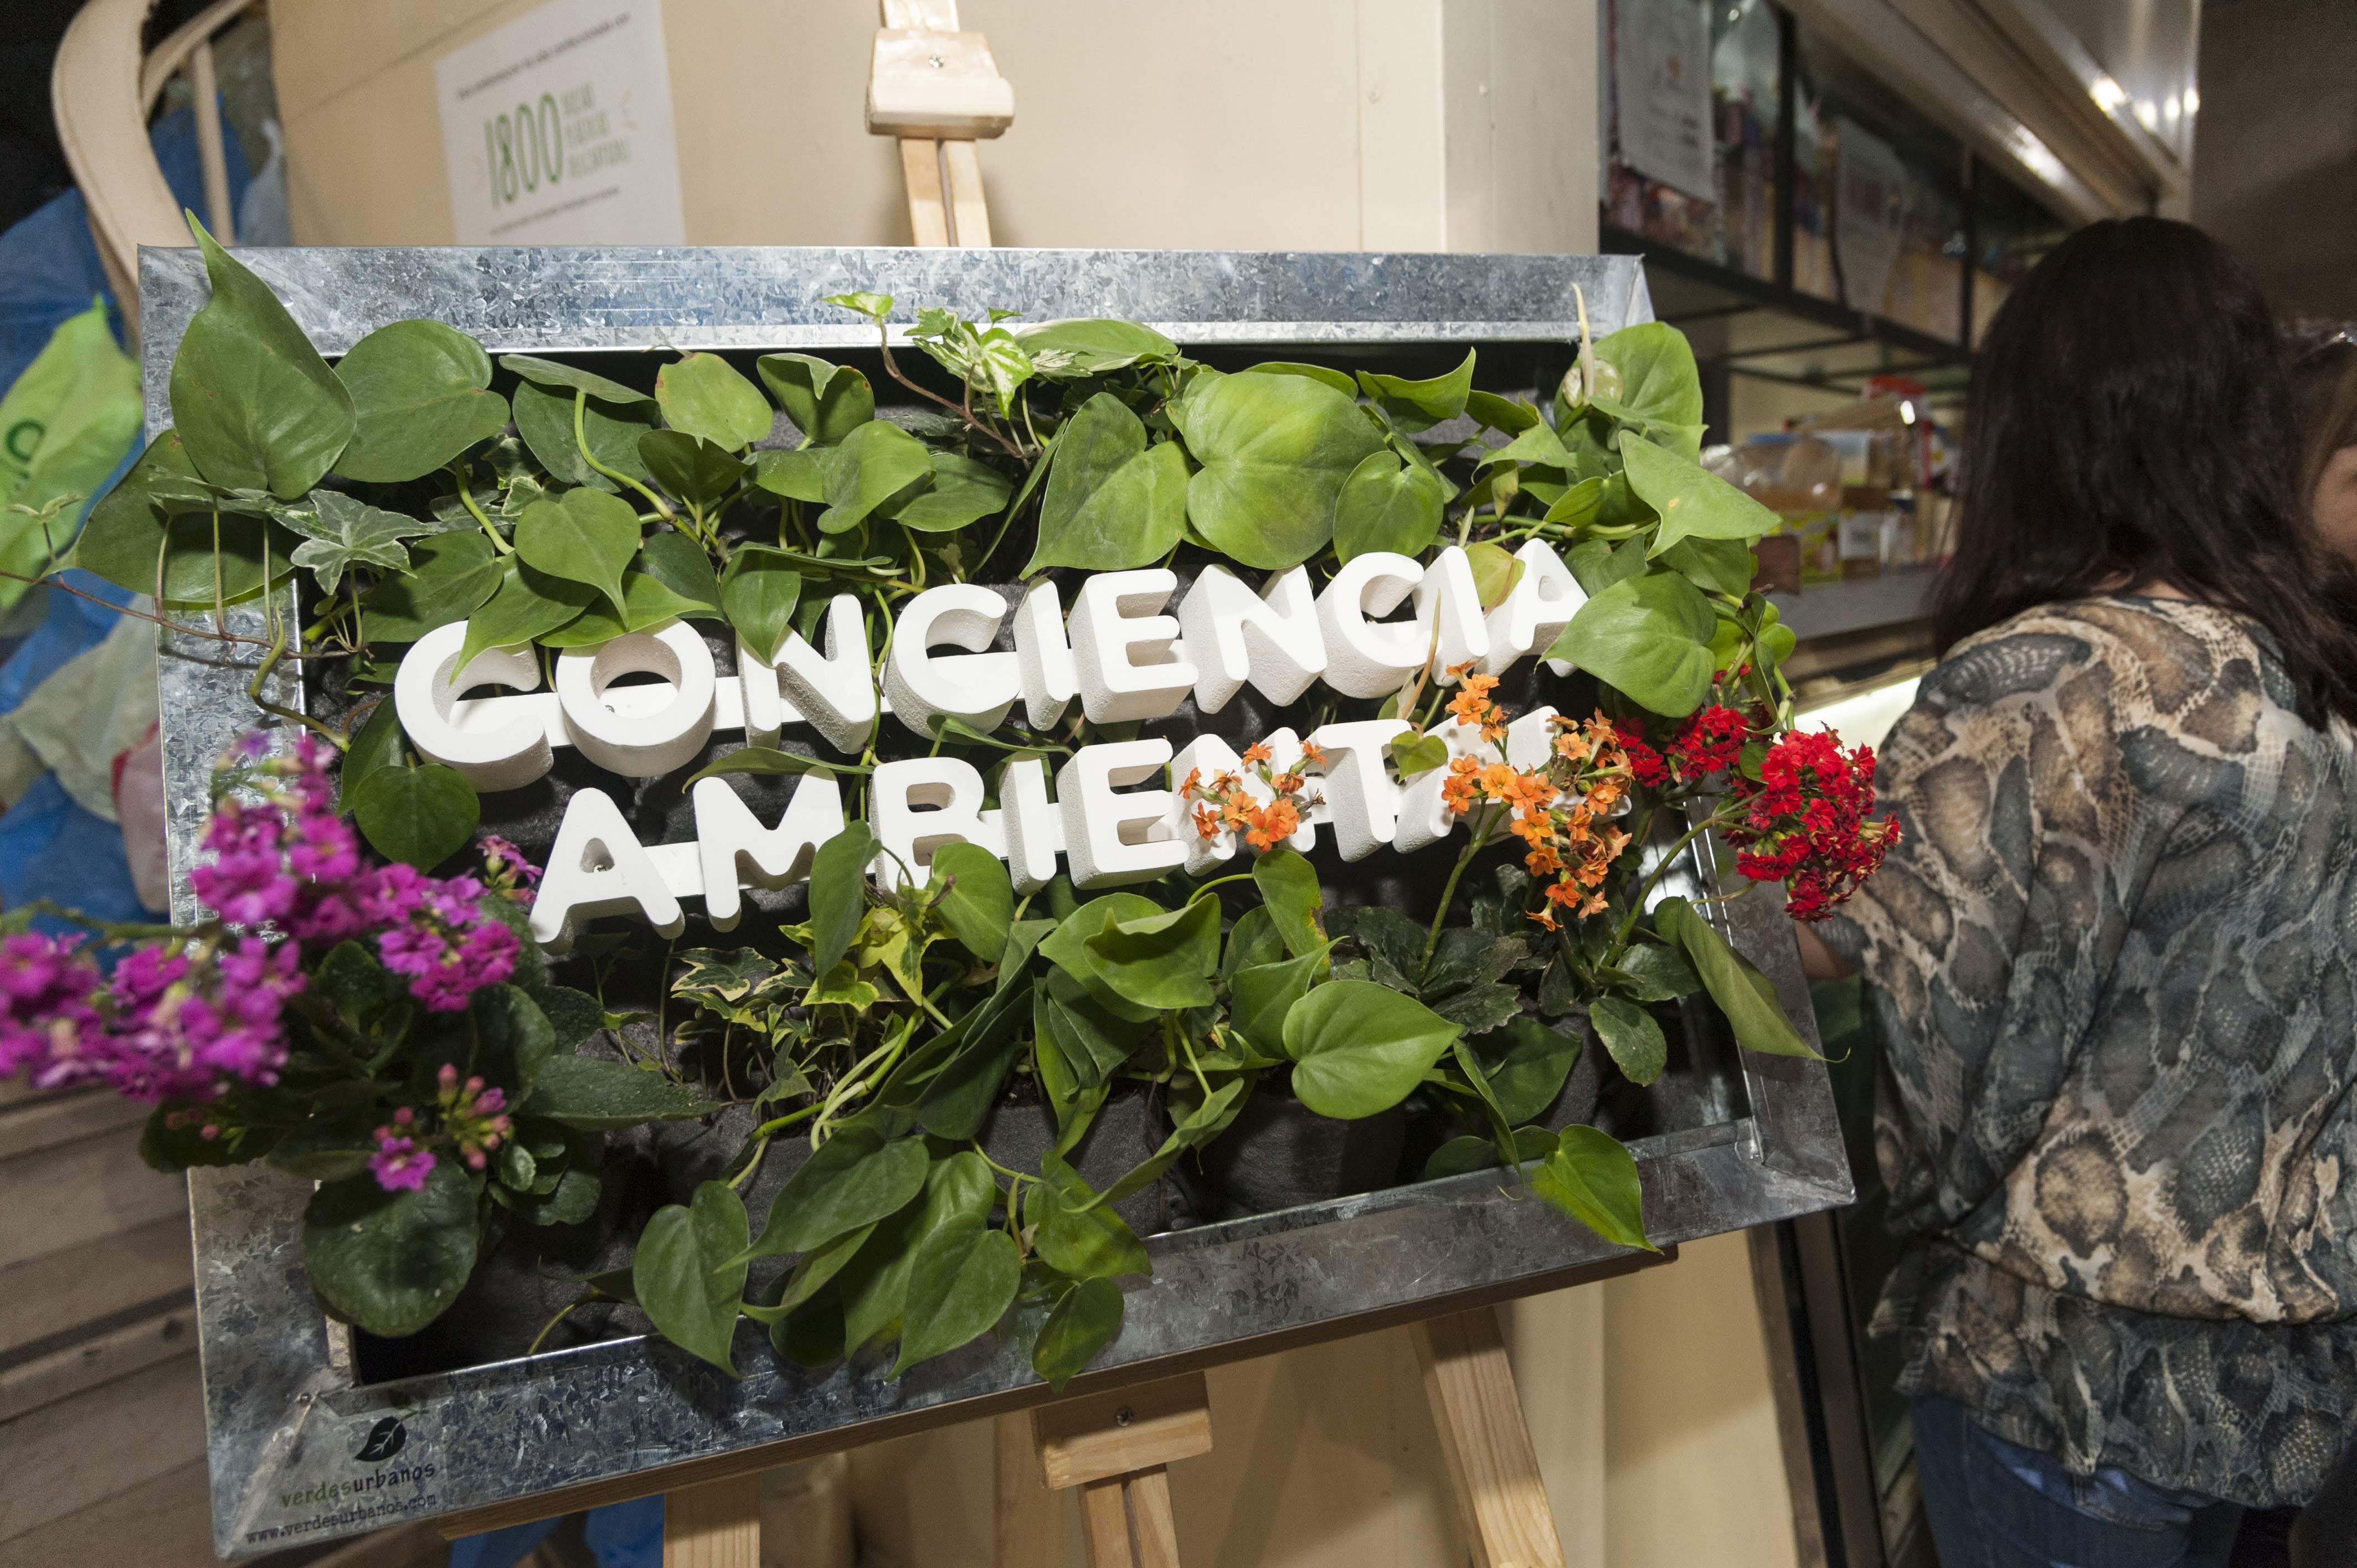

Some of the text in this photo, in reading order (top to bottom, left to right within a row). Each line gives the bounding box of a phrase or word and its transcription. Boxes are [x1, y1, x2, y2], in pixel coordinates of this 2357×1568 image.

[483, 92, 563, 210] 1800
[394, 538, 1591, 792] CONCIENCIA
[246, 1494, 437, 1544] www.verdesurbanos.com
[280, 1463, 435, 1508] verdesurbanos
